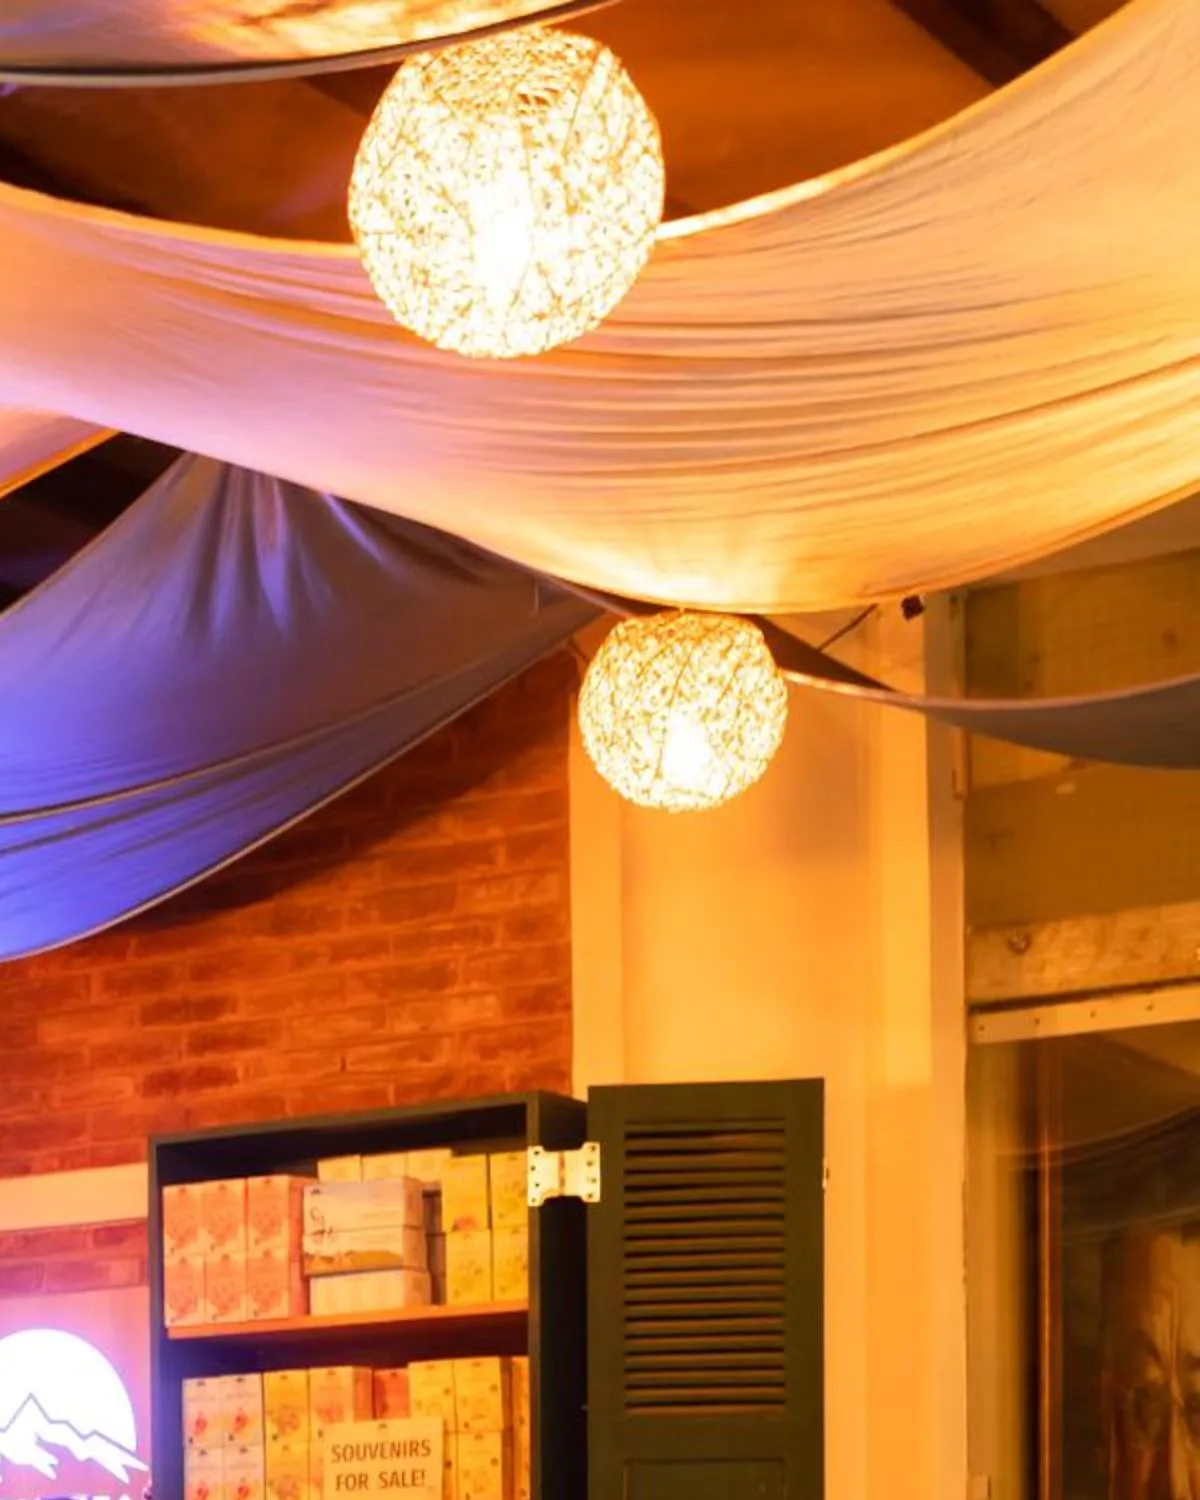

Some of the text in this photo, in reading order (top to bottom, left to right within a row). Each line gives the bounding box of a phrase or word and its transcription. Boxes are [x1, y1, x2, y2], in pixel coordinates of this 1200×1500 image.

[331, 1440, 432, 1463] SOUVENIRS
[335, 1469, 425, 1491] FOR SALE!
